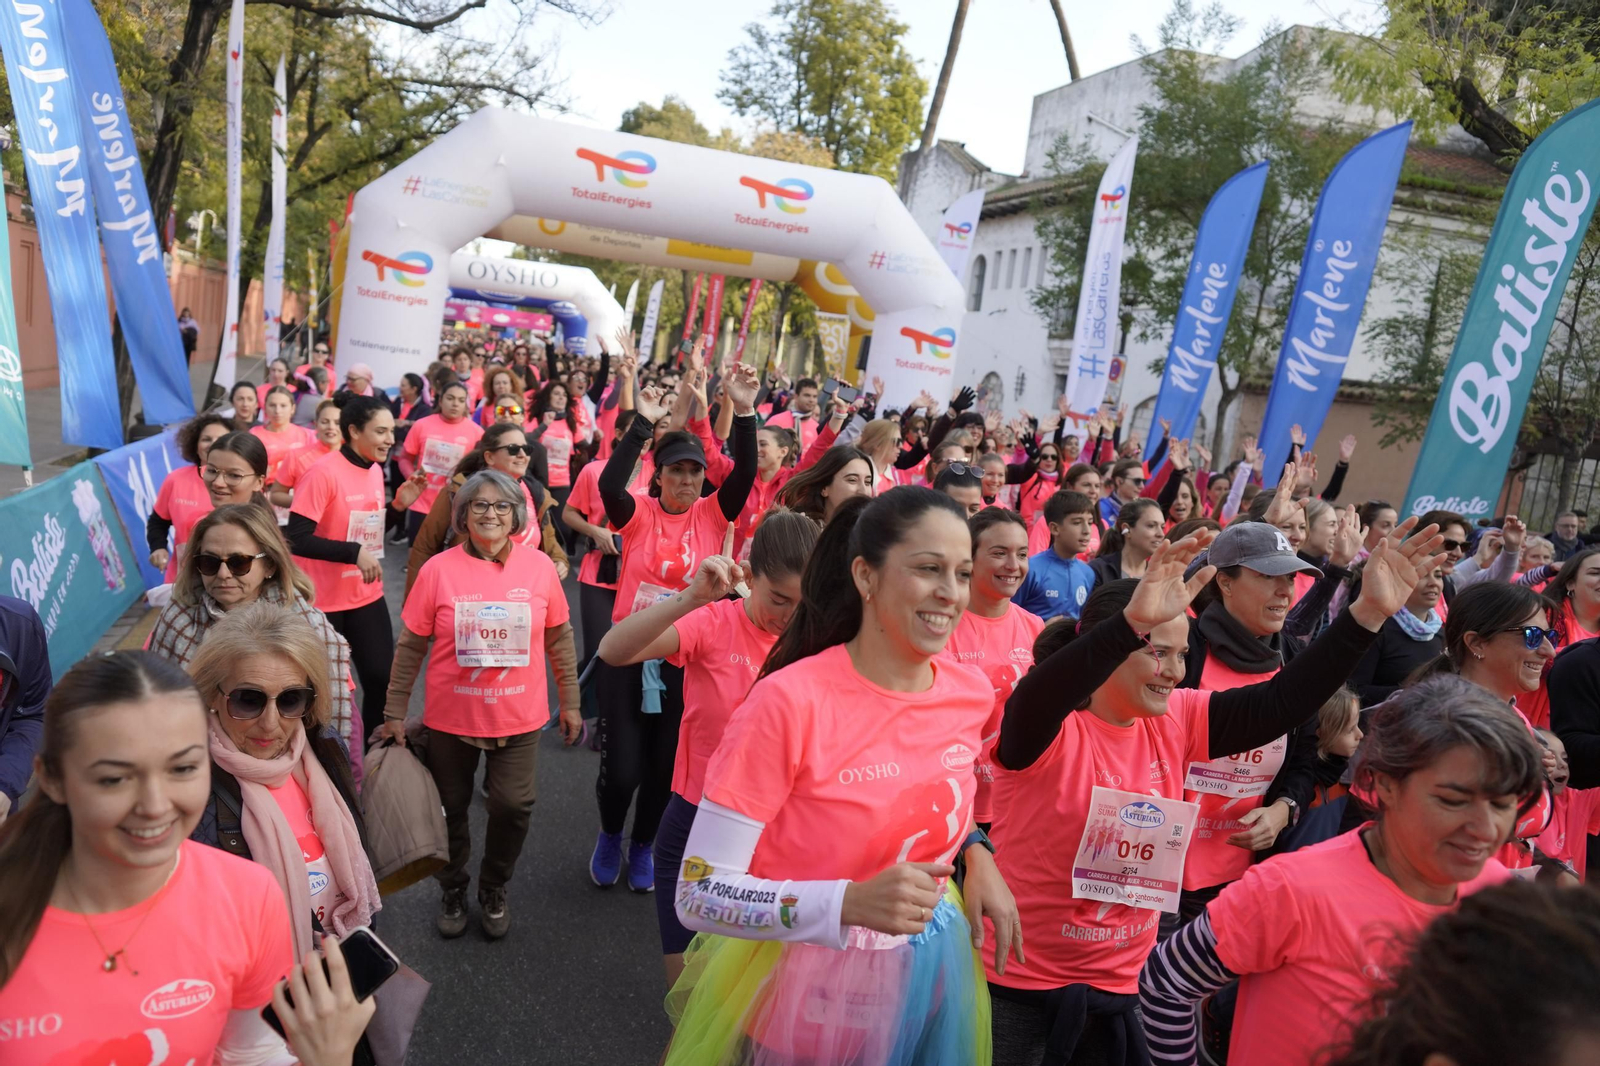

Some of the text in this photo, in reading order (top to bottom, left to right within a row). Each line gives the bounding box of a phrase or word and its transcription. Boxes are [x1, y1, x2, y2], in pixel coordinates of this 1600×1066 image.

[571, 186, 652, 210] TotalEnergies
[734, 213, 809, 235] TotalEnergies
[603, 235, 642, 248] Deportes
[468, 260, 559, 289] OYSHO
[357, 286, 428, 307] TotalEnergies
[1286, 239, 1358, 392] Marlene
[1449, 169, 1591, 454] Batiste
[1170, 261, 1229, 393] Marlene
[349, 337, 421, 355] totalenergies.es
[1411, 494, 1490, 517] Batiste
[1273, 531, 1293, 551] A
[451, 594, 482, 603] OYSHO
[1045, 589, 1059, 598] CRG
[480, 628, 508, 640] 016
[730, 653, 760, 673] OYSO
[454, 685, 525, 696] CARRERA DE LA MUJER
[838, 762, 900, 785] OYSHO
[1203, 770, 1223, 778] CARRERA
[1233, 767, 1250, 776] 5466
[1196, 779, 1228, 791] OYSHO
[1098, 808, 1117, 818] SUMA
[1123, 808, 1162, 824] ASTURIANA
[1117, 840, 1155, 861] 016
[1087, 871, 1109, 880] CARRERA
[1118, 876, 1125, 884] LA
[1144, 879, 1163, 888] SEVILLA
[1080, 883, 1114, 896] OYSHO
[1135, 892, 1165, 904] Santander
[686, 901, 775, 928] TEJUELA
[1061, 923, 1111, 942] CARRERA
[1114, 925, 1128, 940] DE
[148, 991, 210, 1014] ASTURIANA
[0, 1013, 63, 1041] SHO
